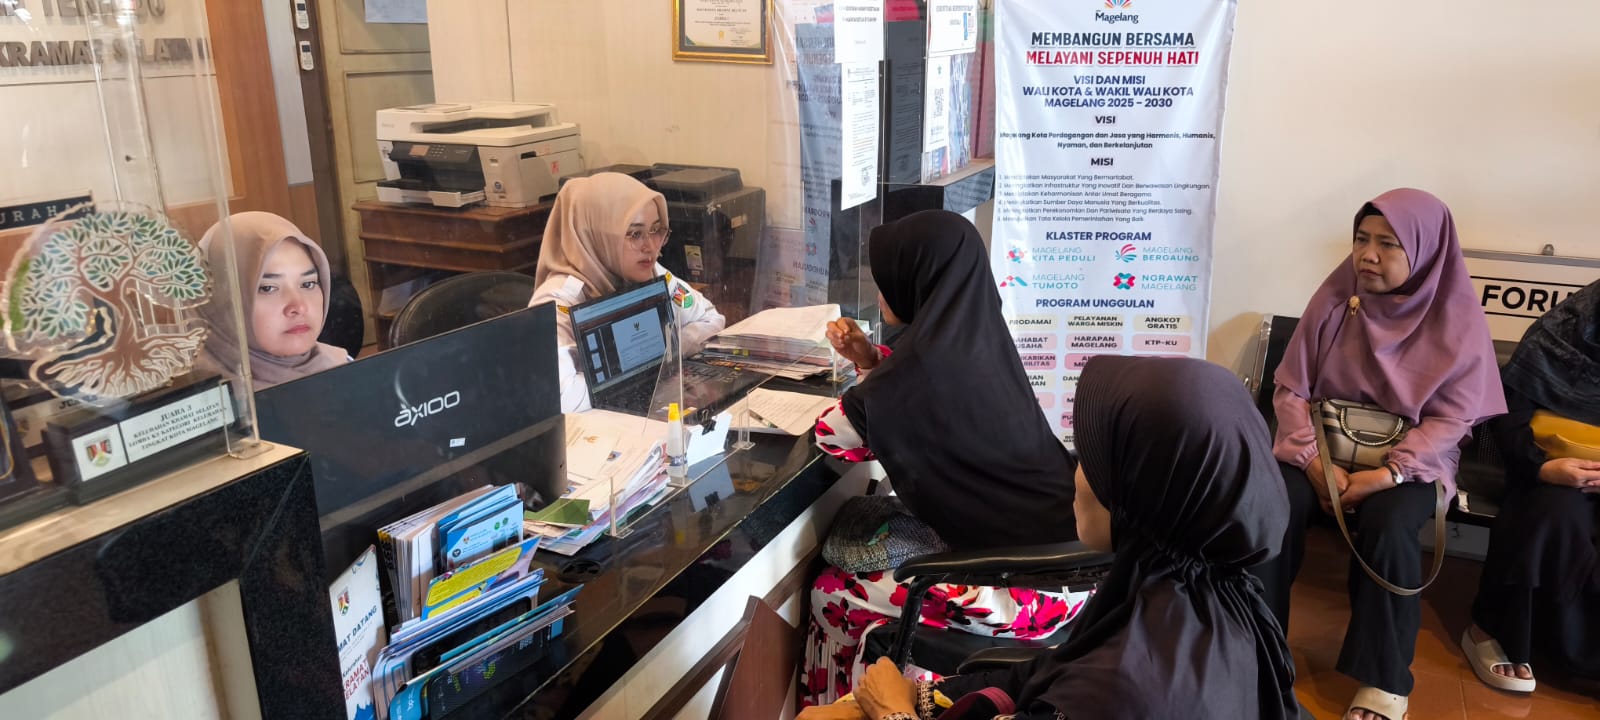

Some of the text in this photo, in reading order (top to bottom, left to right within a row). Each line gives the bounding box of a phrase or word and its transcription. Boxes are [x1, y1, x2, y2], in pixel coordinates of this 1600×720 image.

[1096, 12, 1139, 24] Magelang
[1031, 32, 1194, 46] MEMBANGUN BERSAMA
[1026, 51, 1199, 65] MELAYANI SEPENUH HATI
[1074, 75, 1145, 85] VISI DAN MISI
[1023, 87, 1194, 97] WALI KOTA & WAKIL WALI KOTA
[1045, 98, 1105, 107] MAGELANG
[1107, 98, 1134, 107] 2025
[1144, 98, 1173, 107] 2030
[1095, 115, 1115, 124] VISI
[1104, 142, 1152, 150] Berkelanjutan
[1090, 158, 1113, 166] MISI
[1046, 232, 1151, 241] KLASTER PROGRAM
[1142, 283, 1197, 291] MAGELANG
[1036, 299, 1154, 308] PROGRAM UNGGULAN
[352, 605, 377, 637] DATANG
[344, 658, 368, 690] RAMAT
